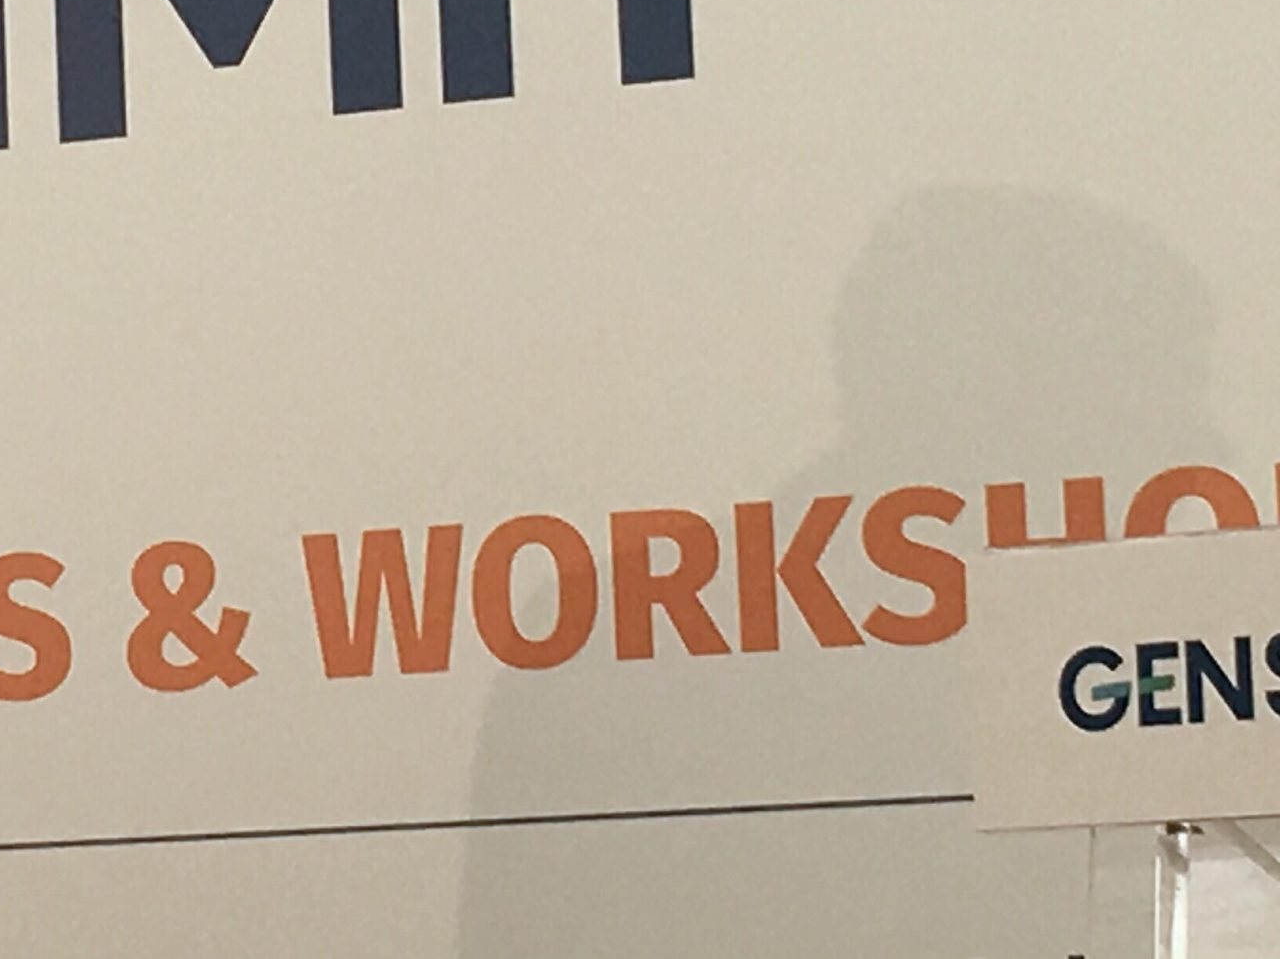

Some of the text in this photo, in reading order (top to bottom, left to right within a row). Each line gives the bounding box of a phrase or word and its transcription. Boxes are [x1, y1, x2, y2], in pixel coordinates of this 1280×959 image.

[125, 540, 259, 693] &
[301, 463, 1280, 679] WORKS
[1059, 633, 1280, 733] GEN
